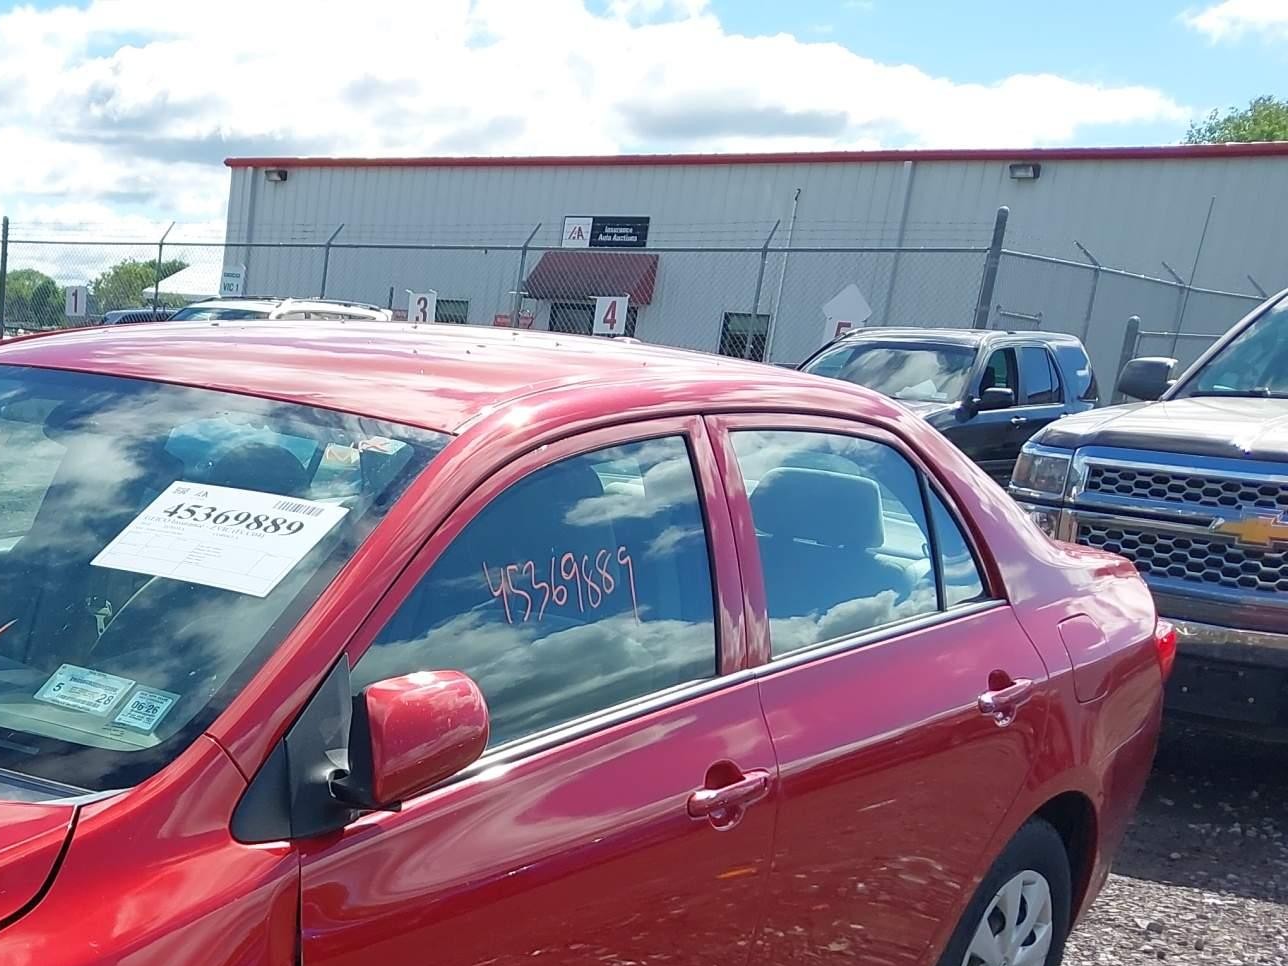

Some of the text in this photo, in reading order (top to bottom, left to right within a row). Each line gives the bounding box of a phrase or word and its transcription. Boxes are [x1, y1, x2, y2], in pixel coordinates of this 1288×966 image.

[612, 234, 638, 242] Auctions
[72, 289, 78, 313] 1
[416, 296, 428, 322] 3
[603, 300, 617, 330] 4
[163, 502, 305, 536] 45369889
[482, 546, 640, 625] 45369889
[53, 682, 65, 692] 5
[96, 694, 114, 705] 28
